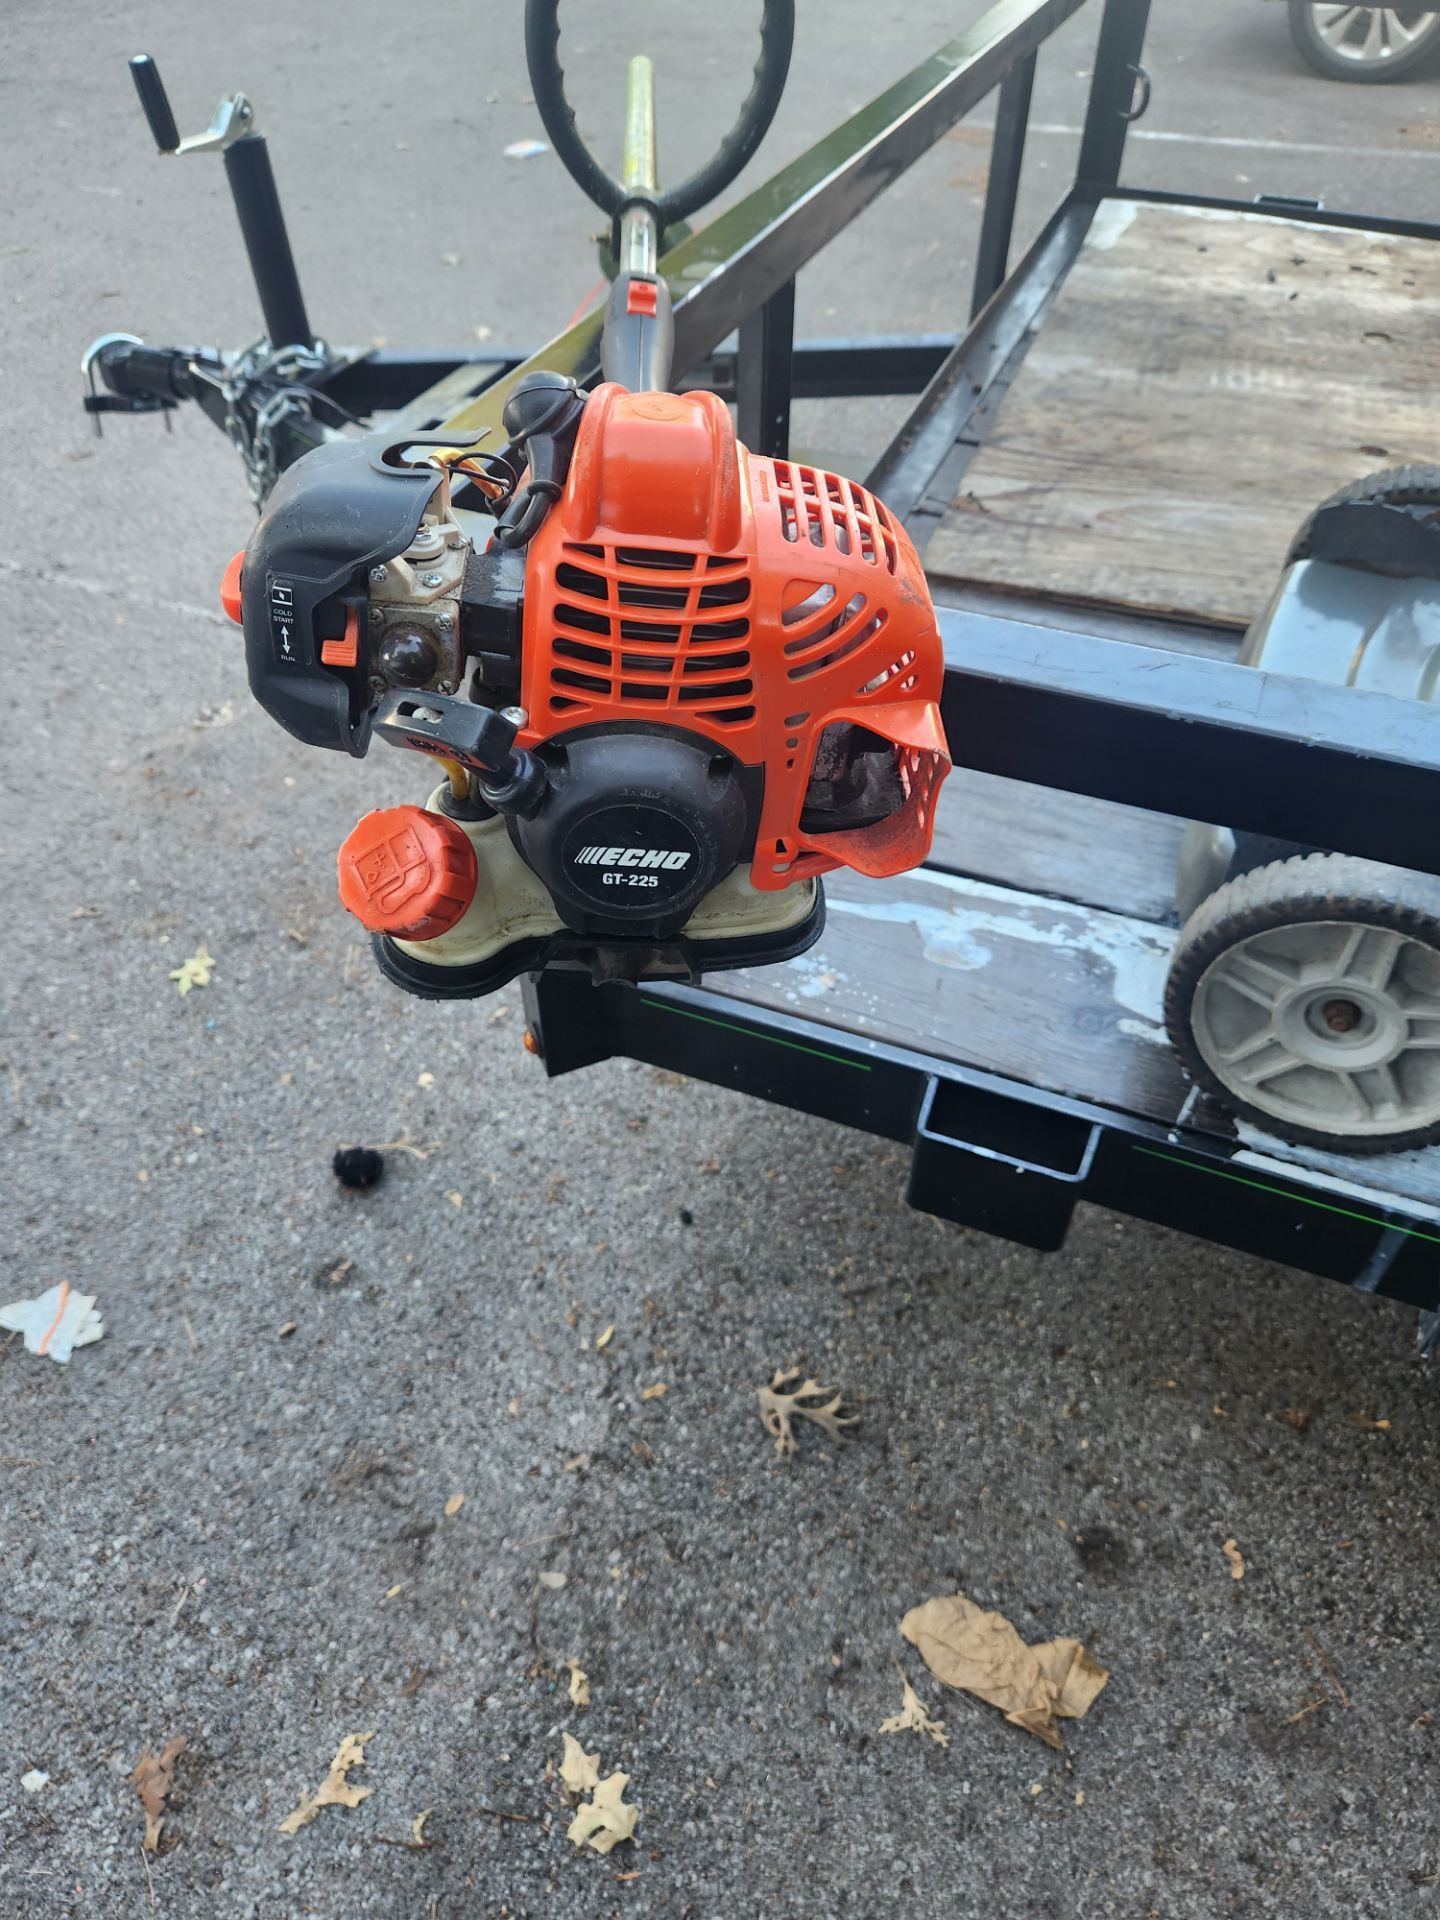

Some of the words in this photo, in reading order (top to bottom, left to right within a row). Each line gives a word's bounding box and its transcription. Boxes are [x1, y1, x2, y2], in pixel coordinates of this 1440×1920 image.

[273, 608, 293, 617] COLD
[273, 615, 295, 625] START
[280, 654, 296, 662] RUN
[596, 846, 691, 870] ECHO
[602, 872, 659, 887] GT-225
